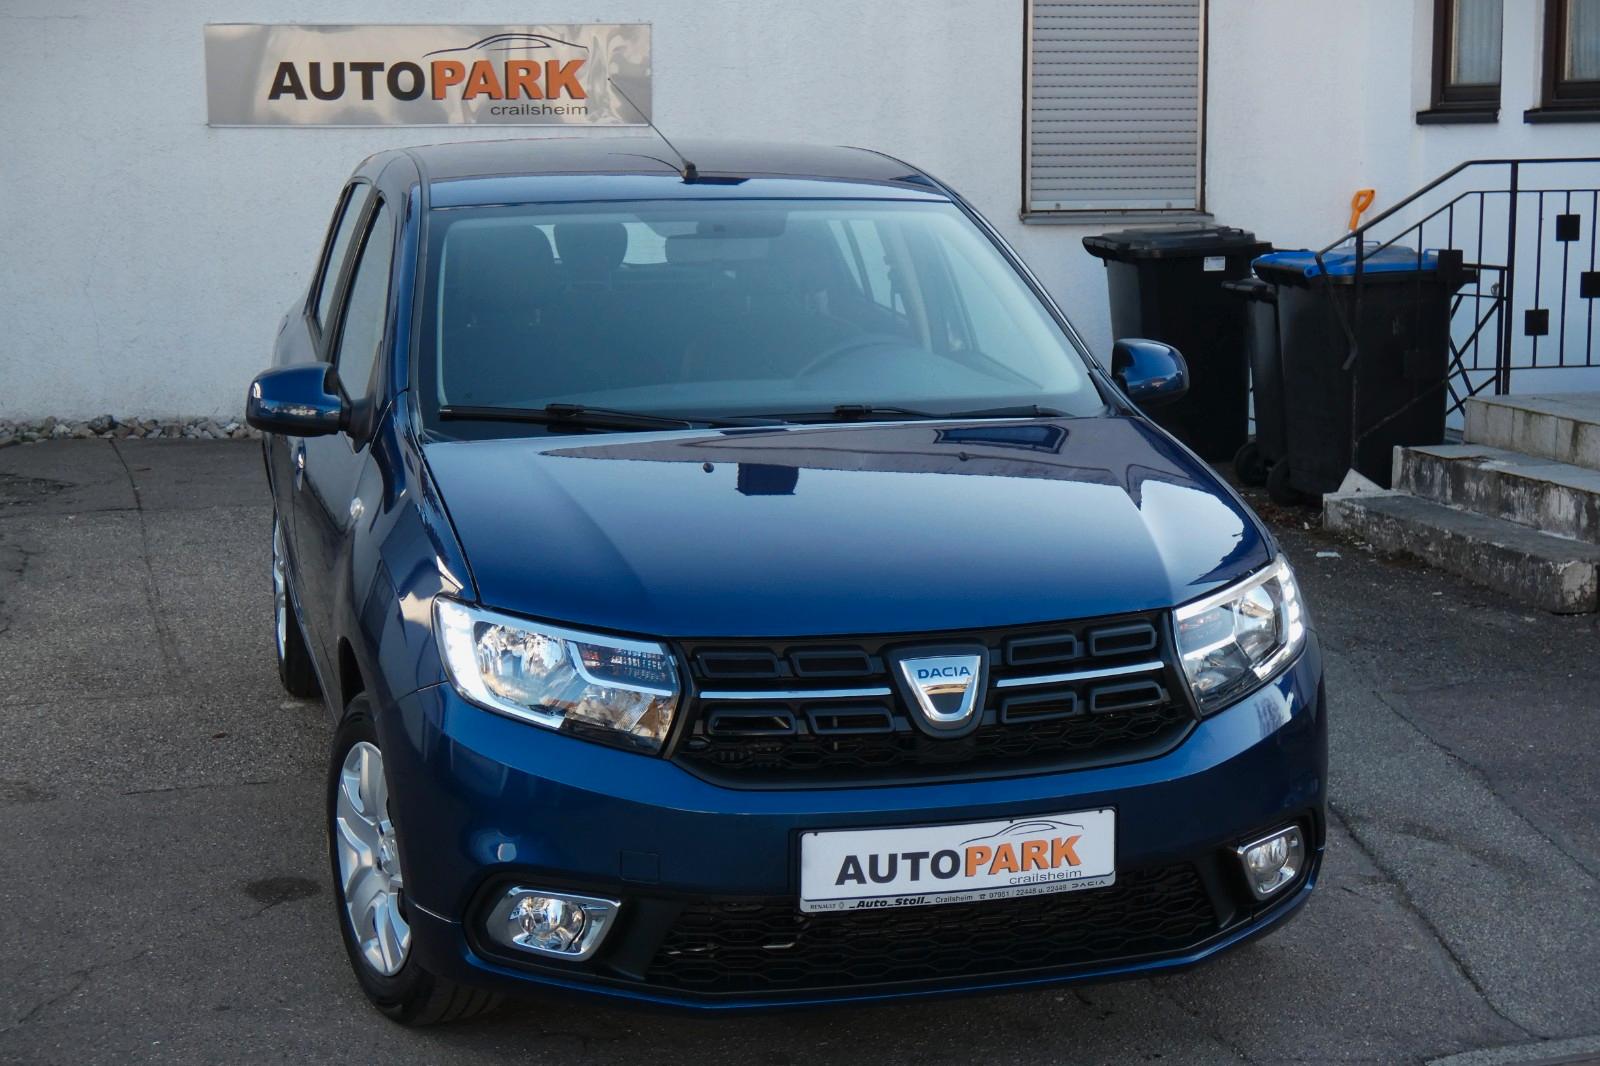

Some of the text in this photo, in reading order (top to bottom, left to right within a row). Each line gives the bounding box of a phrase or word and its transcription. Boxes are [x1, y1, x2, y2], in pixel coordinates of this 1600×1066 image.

[268, 59, 589, 102] AUTOPARK
[490, 103, 589, 116] crailsheim
[917, 666, 972, 680] DACIA
[835, 834, 1083, 886] AUTOPARK
[1009, 869, 1083, 885] crailsheim
